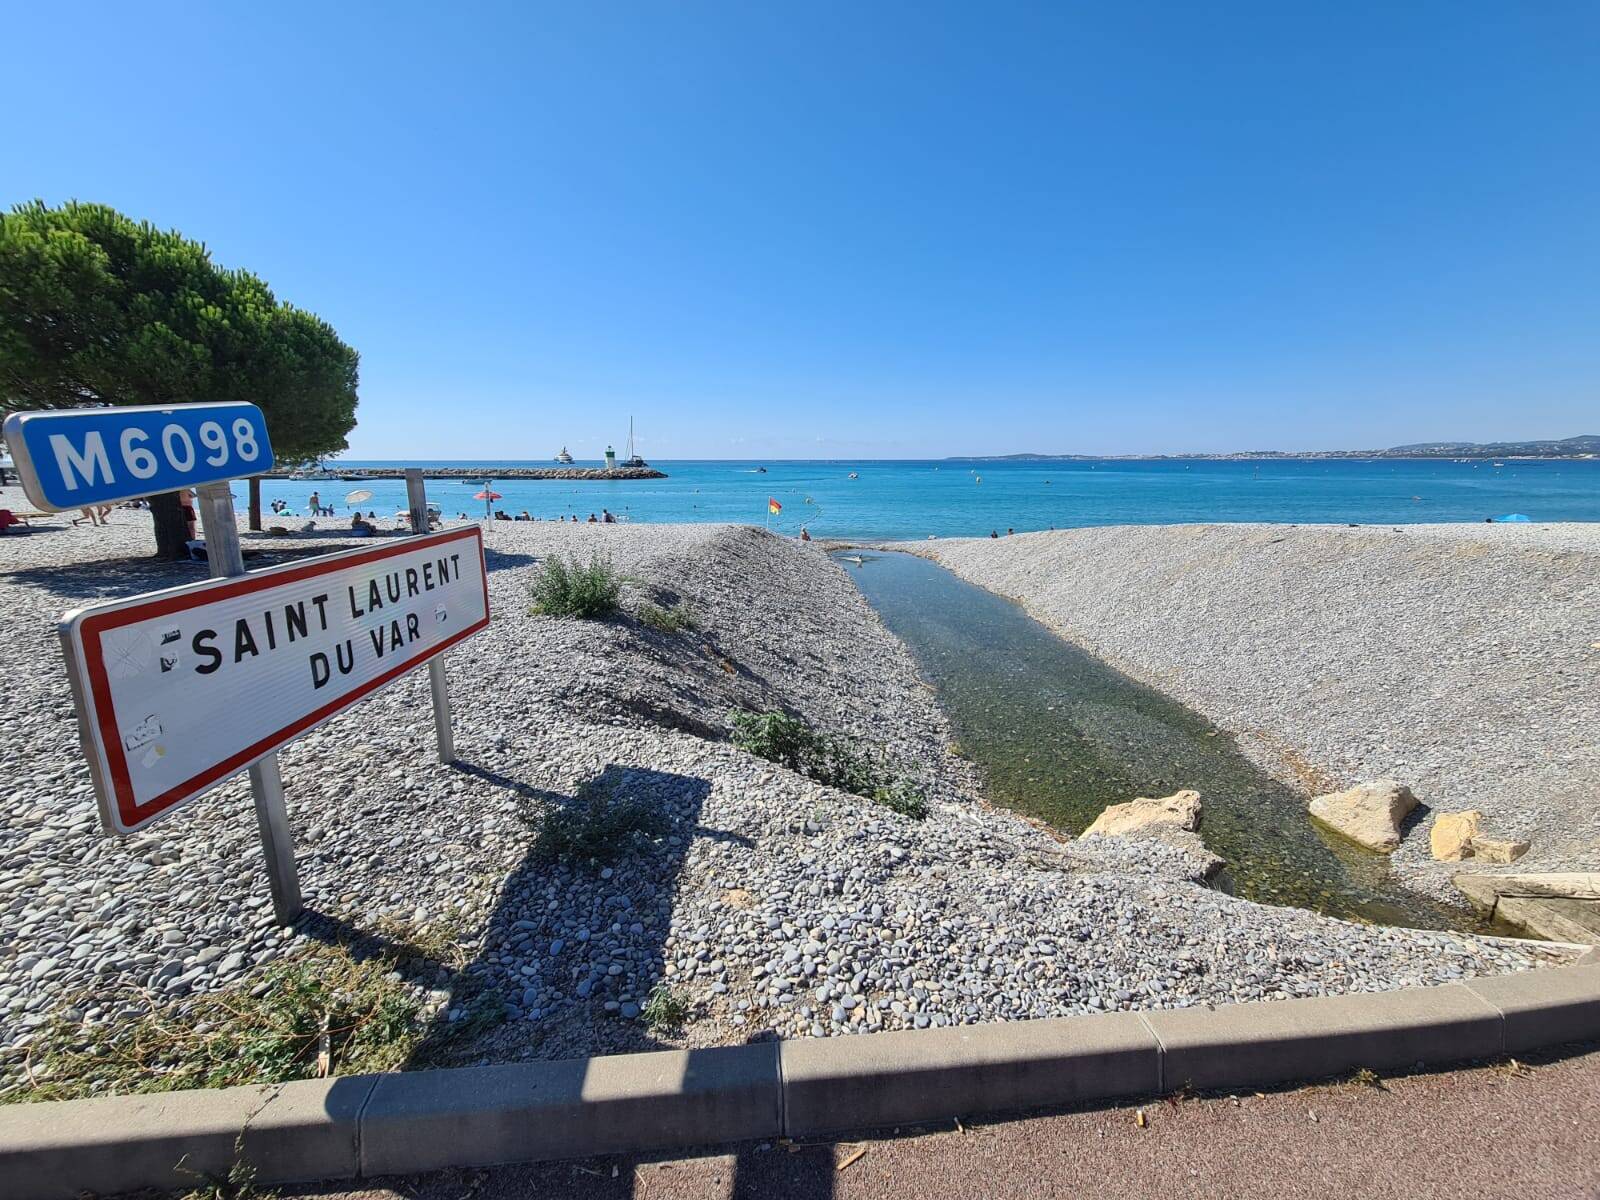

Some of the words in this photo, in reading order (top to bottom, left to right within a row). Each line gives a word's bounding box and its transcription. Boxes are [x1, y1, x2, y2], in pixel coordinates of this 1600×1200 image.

[49, 418, 259, 491] M6098
[192, 593, 329, 675] SAINT
[348, 553, 460, 619] LAURENT
[309, 643, 355, 690] DU
[369, 612, 421, 659] VAR
